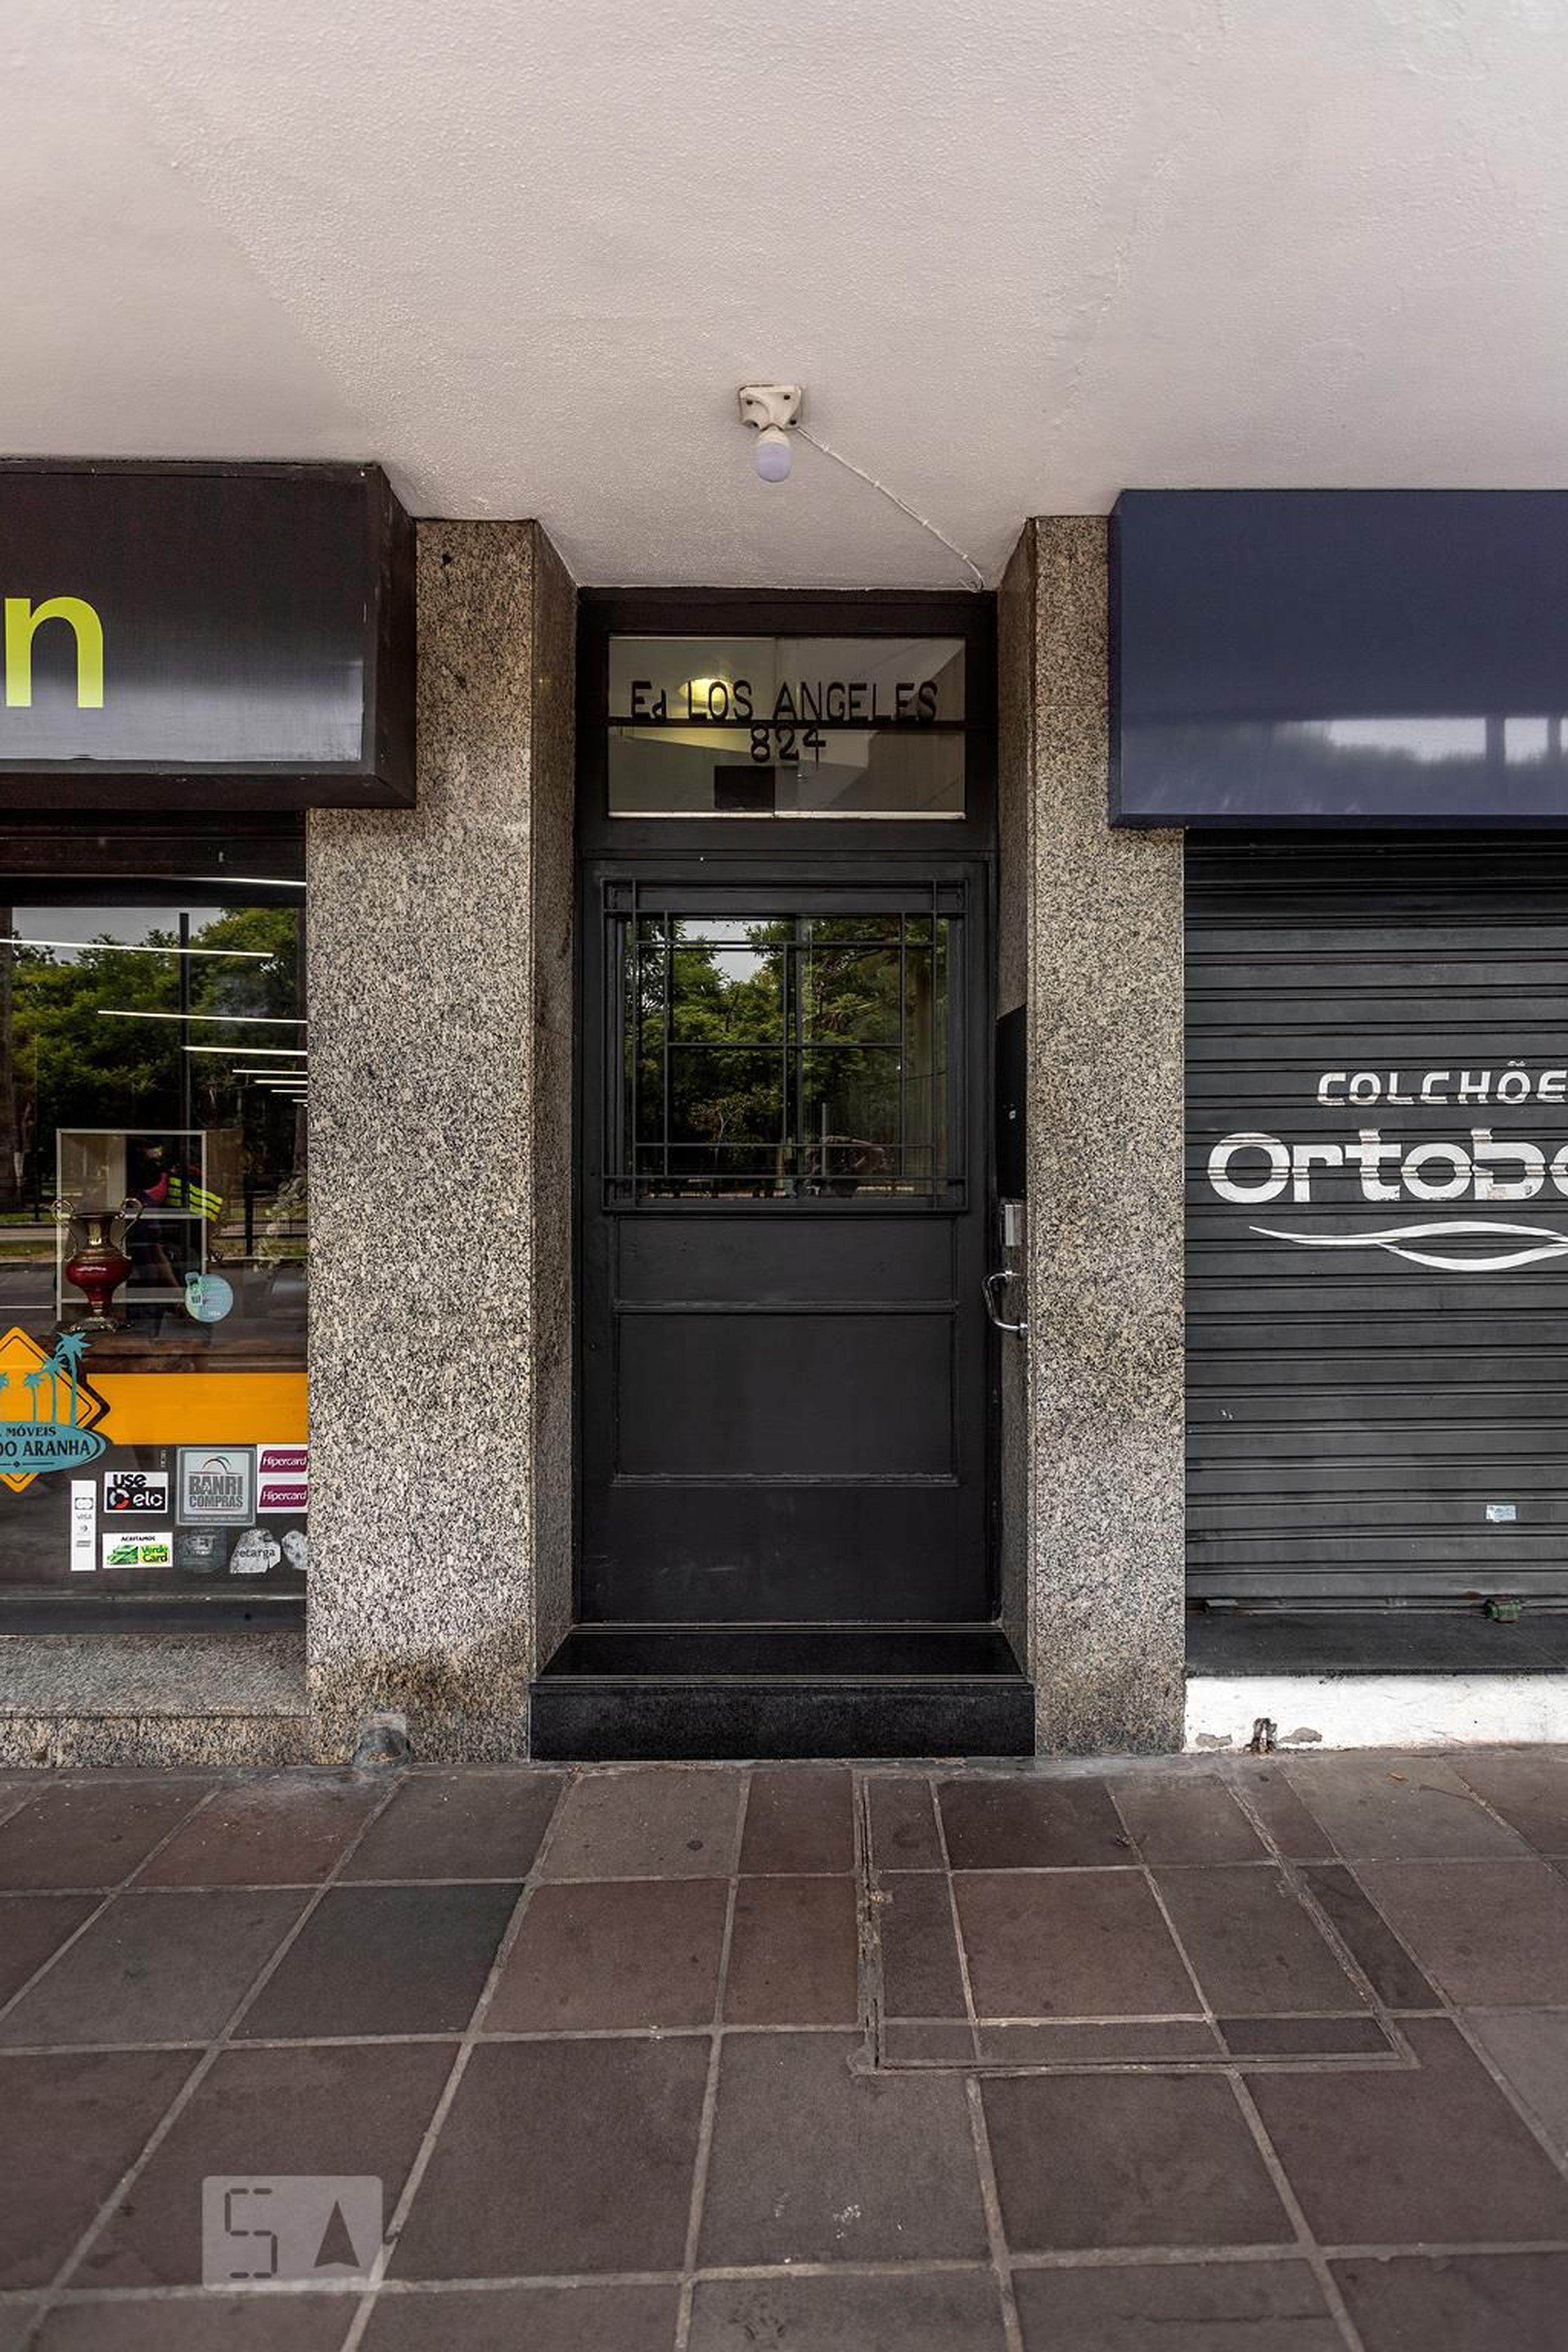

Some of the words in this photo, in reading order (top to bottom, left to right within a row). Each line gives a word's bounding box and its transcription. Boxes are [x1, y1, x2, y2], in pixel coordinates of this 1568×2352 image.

[688, 679, 753, 721] LOS
[773, 680, 938, 722] ANGELES
[751, 724, 826, 772] 824
[6, 1425, 57, 1437] MÓVEIS
[23, 1439, 91, 1457] ARANHA
[263, 1455, 306, 1468] Hipercard
[189, 1476, 243, 1495] BANRI
[189, 1494, 243, 1508] COMPRAS
[263, 1490, 306, 1502] Hipercard
